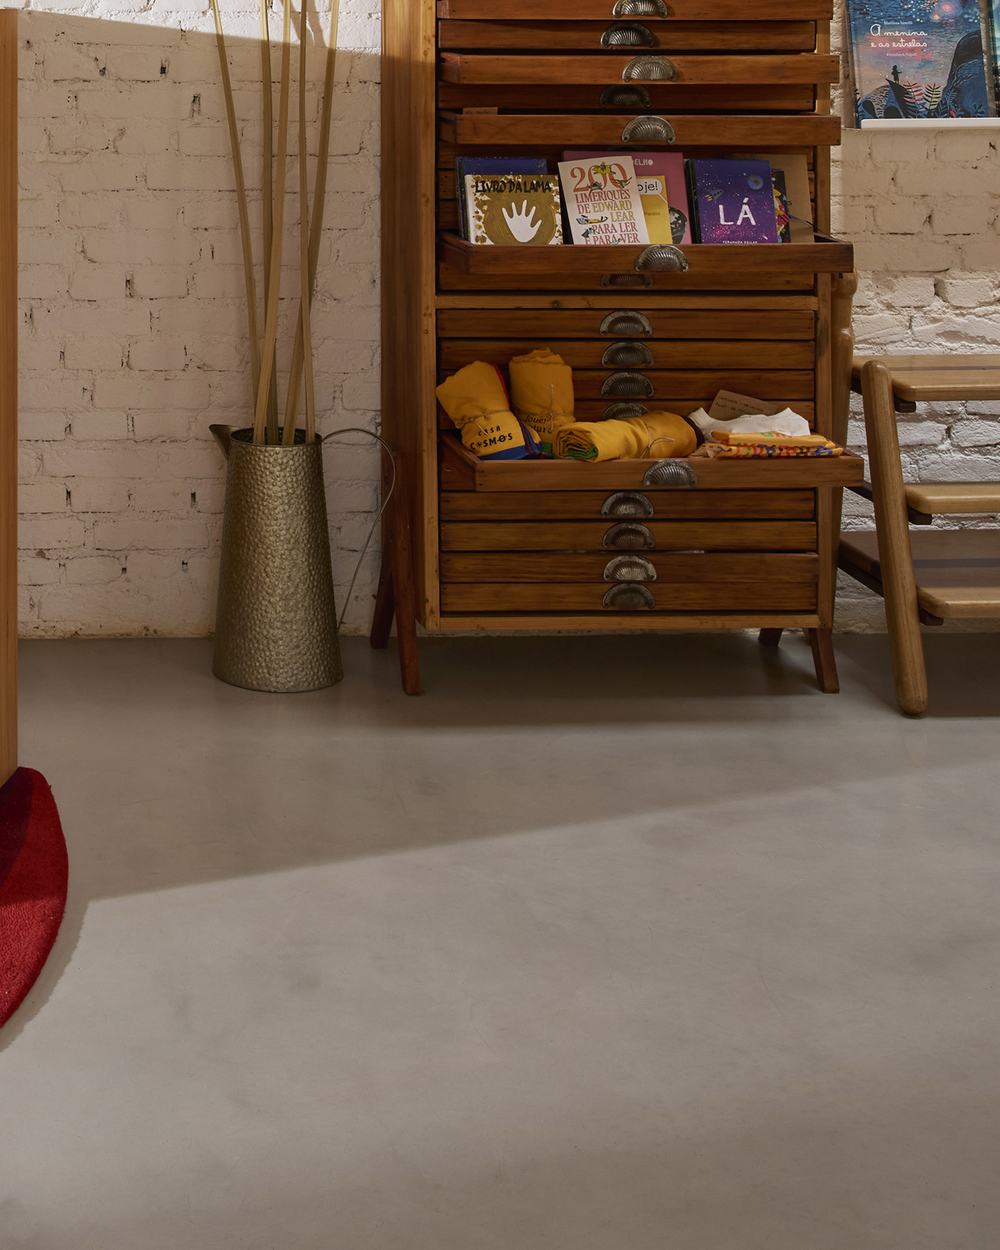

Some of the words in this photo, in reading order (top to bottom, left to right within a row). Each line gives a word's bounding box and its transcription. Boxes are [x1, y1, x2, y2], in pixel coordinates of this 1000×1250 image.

[883, 29, 928, 37] menina
[892, 38, 928, 48] estrelas
[633, 158, 654, 166] ELHO
[570, 162, 628, 193] 200
[475, 180, 507, 194] LIVRO
[507, 180, 523, 194] DA
[523, 180, 552, 194] LAMA
[574, 188, 631, 204] LIMERIQUES
[576, 204, 592, 215] DE
[592, 199, 633, 213] EDWARD
[718, 197, 757, 226] LÁ
[610, 210, 637, 223] LEAR
[592, 223, 618, 235] PARA
[619, 221, 639, 233] LER
[592, 234, 617, 244] PARA
[620, 233, 641, 244] VER
